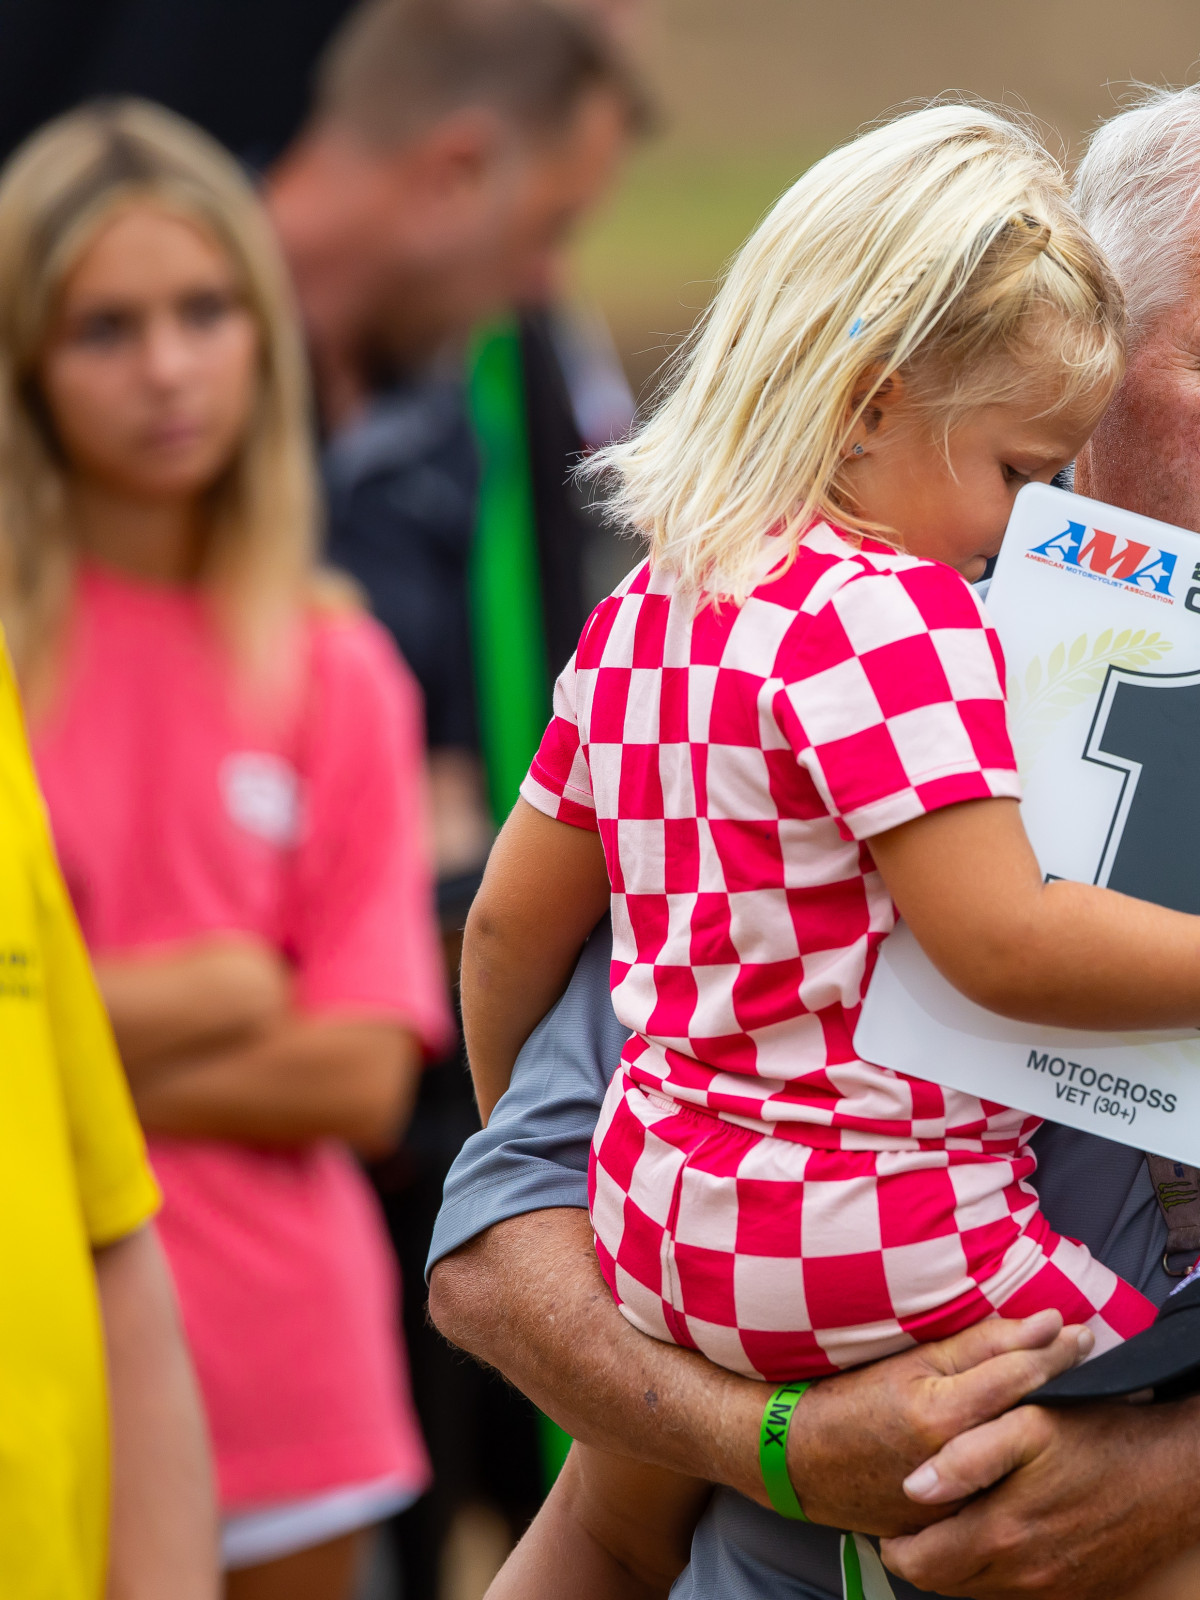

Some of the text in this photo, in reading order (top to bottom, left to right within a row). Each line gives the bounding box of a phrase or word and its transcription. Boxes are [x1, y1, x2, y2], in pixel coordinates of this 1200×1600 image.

[1024, 552, 1175, 606] AMERICAN MOTORCYCLIST ASSOCIATION
[1027, 519, 1176, 598] AMA
[1026, 1050, 1178, 1113] MOTOCROSS
[1055, 1082, 1137, 1126] VET (30+)
